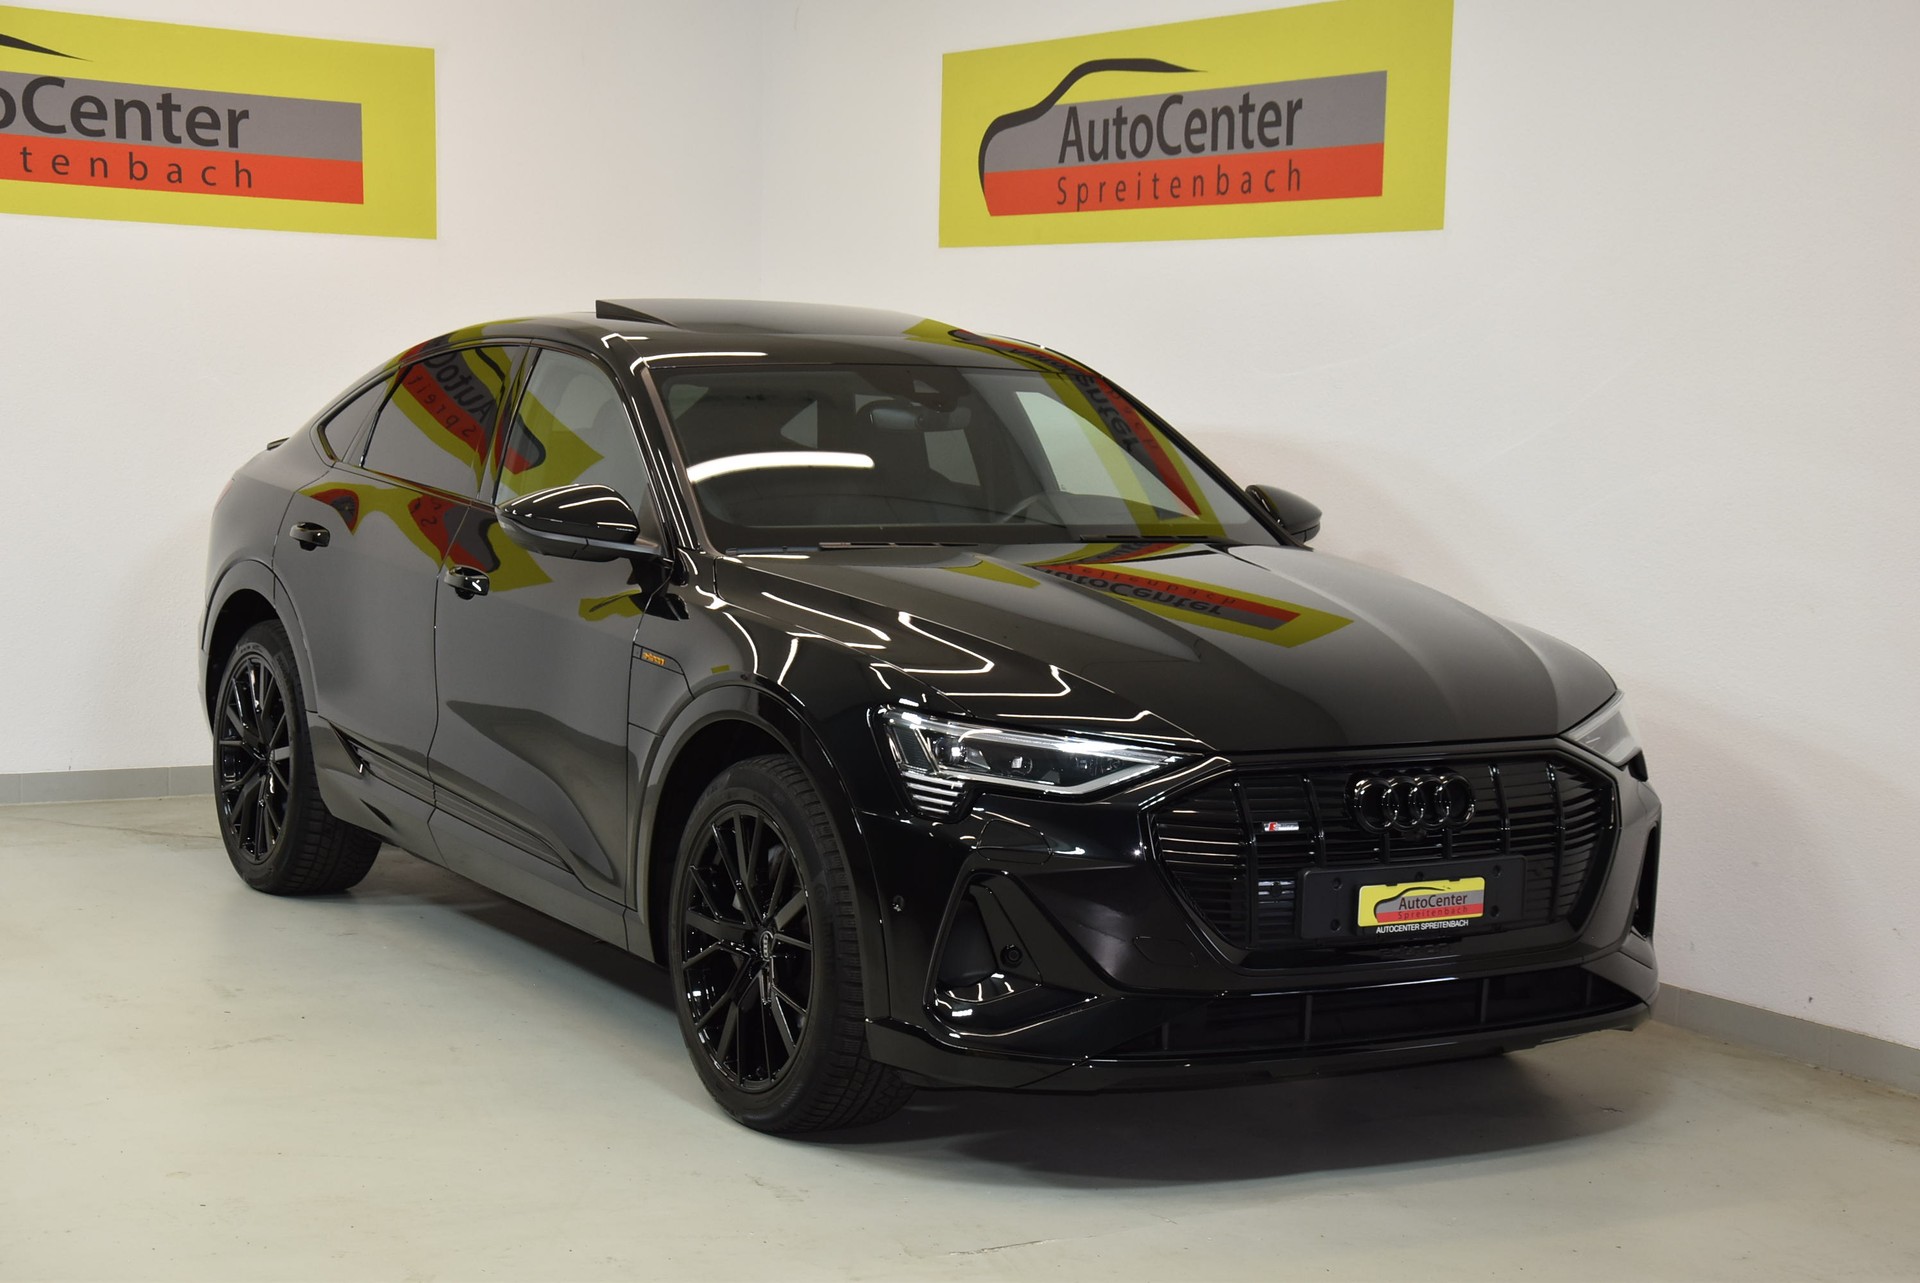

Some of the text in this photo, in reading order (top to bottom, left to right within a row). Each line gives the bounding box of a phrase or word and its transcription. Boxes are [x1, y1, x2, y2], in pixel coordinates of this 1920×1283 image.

[1058, 91, 1303, 164] AutoCenter
[1057, 159, 1303, 212] Spreitenbach
[1398, 894, 1468, 911] AutoCenter
[1397, 907, 1468, 919] Spreitenbach
[1376, 919, 1469, 934] AUTOCENTER SPREITENBACH
